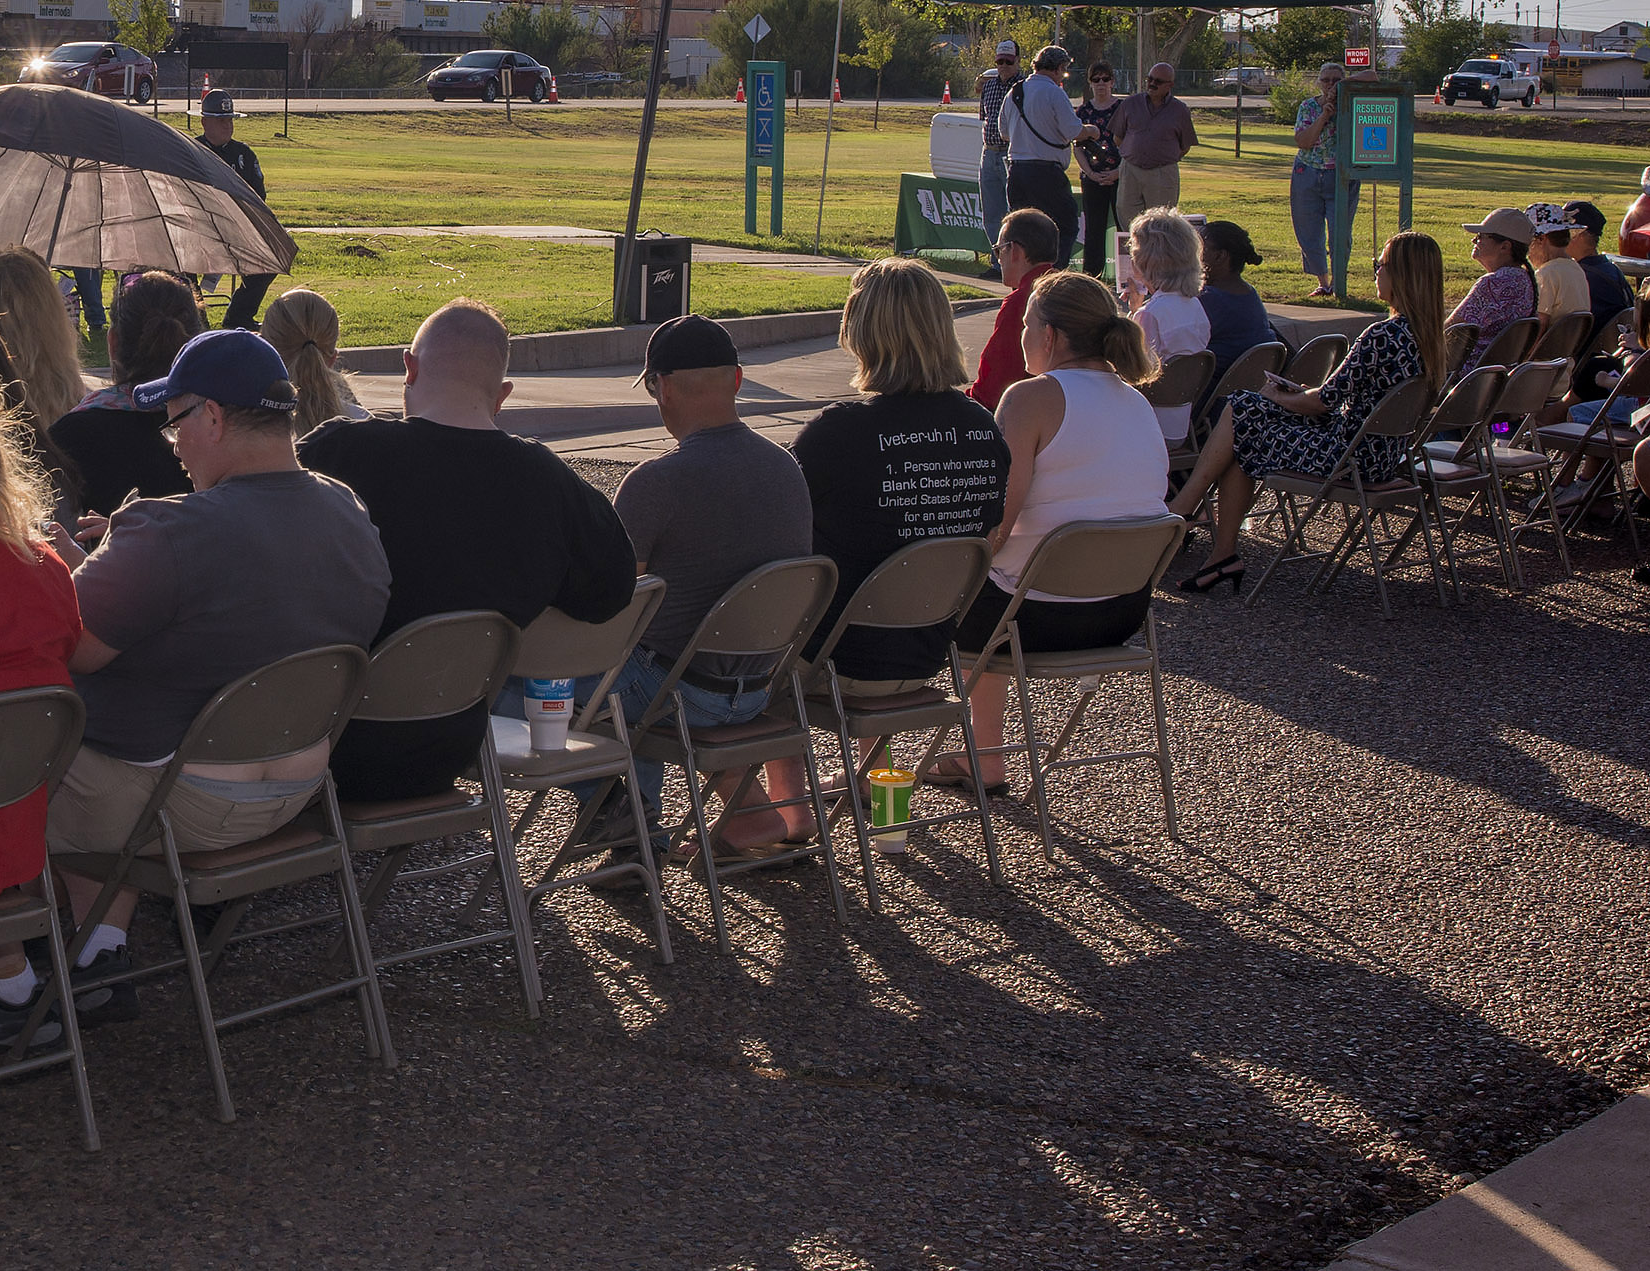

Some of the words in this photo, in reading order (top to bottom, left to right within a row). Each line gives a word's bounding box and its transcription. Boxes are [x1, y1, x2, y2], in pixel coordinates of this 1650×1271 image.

[39, 5, 72, 18] Intermodal
[1356, 104, 1395, 114] RESERVED
[1358, 115, 1392, 125] PARKING
[941, 190, 983, 218] ARIZ
[943, 215, 969, 227] STATE
[260, 398, 278, 409] FIRE
[965, 429, 995, 441] -noun
[886, 463, 898, 475] 1.
[904, 460, 941, 473] Person
[943, 460, 962, 471] who
[963, 459, 990, 470] wrote
[991, 460, 996, 468] a
[882, 478, 918, 493] Blank
[919, 477, 951, 490] Check
[952, 475, 987, 489] payable
[988, 475, 997, 484] to
[878, 495, 918, 508] United
[920, 493, 951, 505] States
[952, 492, 963, 503] of
[963, 489, 1000, 503] America
[904, 511, 921, 523] for
[922, 511, 935, 521] an
[937, 508, 972, 521] amount
[972, 506, 983, 517] of
[898, 527, 912, 539] up
[914, 526, 925, 537] to
[927, 524, 945, 536] and
[946, 521, 984, 535] including
